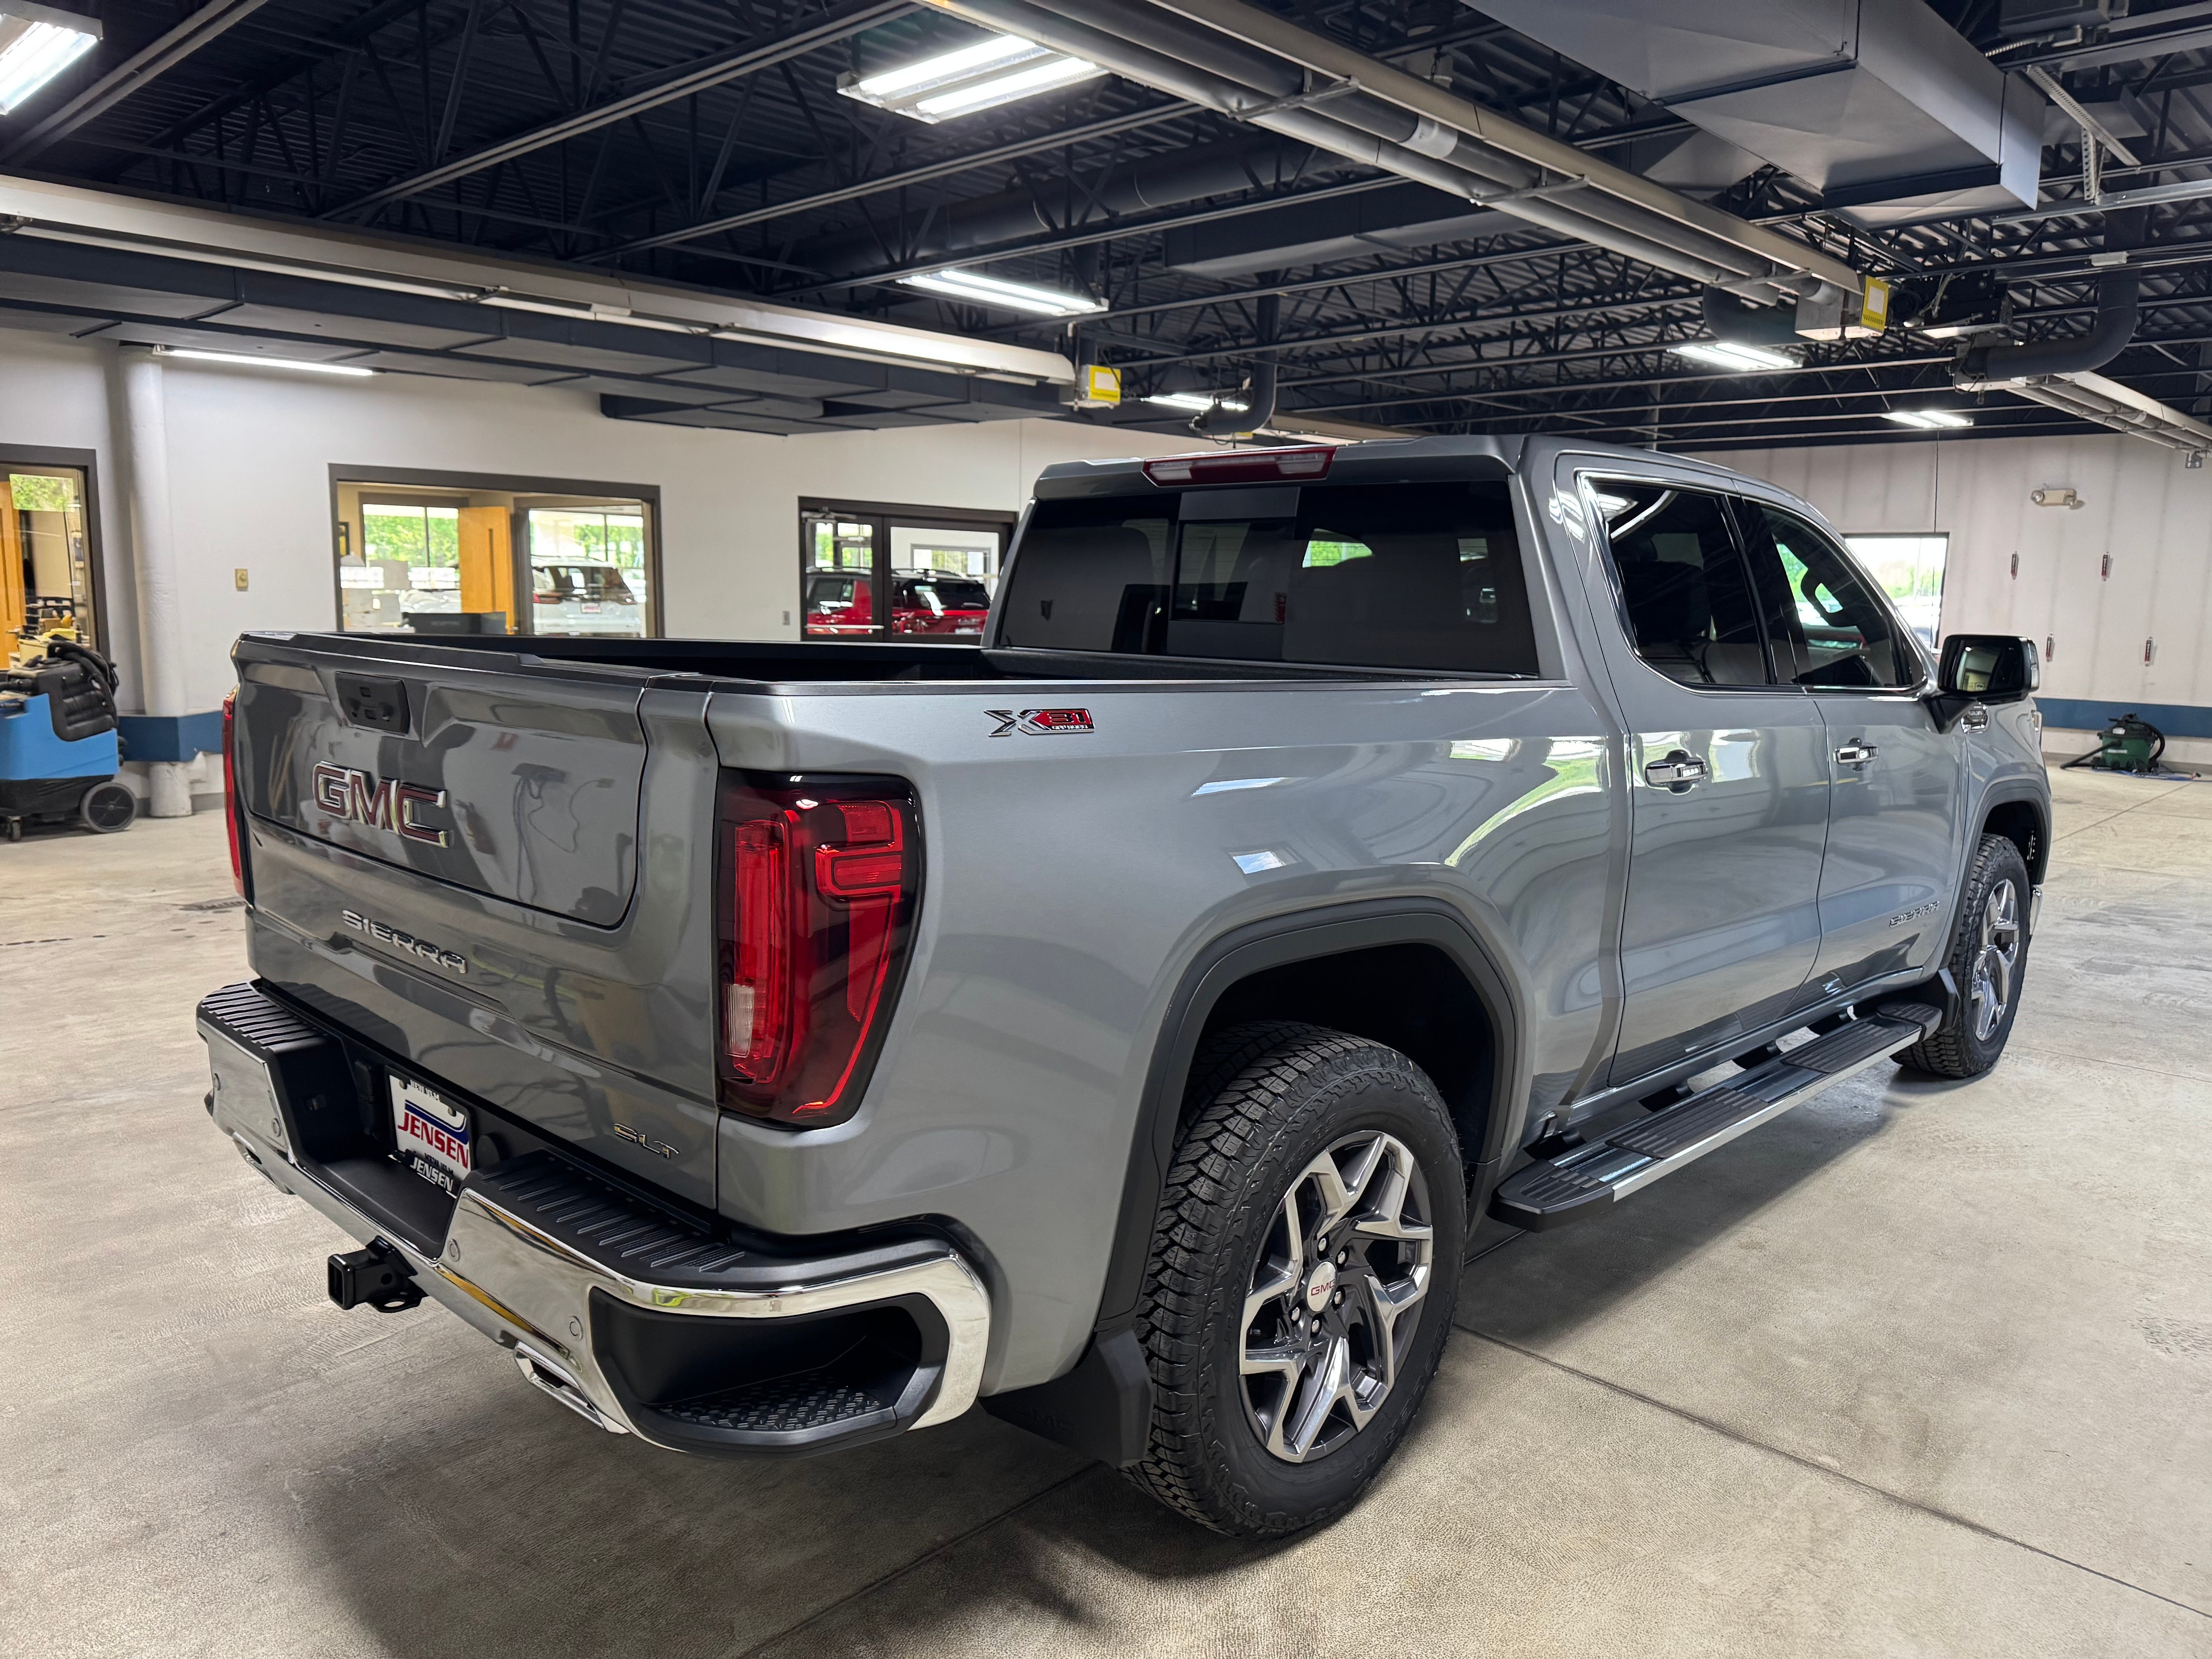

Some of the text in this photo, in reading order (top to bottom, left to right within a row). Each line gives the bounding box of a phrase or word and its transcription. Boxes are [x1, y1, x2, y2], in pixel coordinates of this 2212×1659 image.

[313, 760, 449, 848] GMC
[1889, 900, 1940, 927] SIERRA
[342, 909, 467, 974] SIERRA
[397, 1111, 469, 1170] JENSEN
[614, 1123, 680, 1159] SLT
[410, 1157, 453, 1192] JENSEN
[1311, 1279, 1335, 1296] GMC
